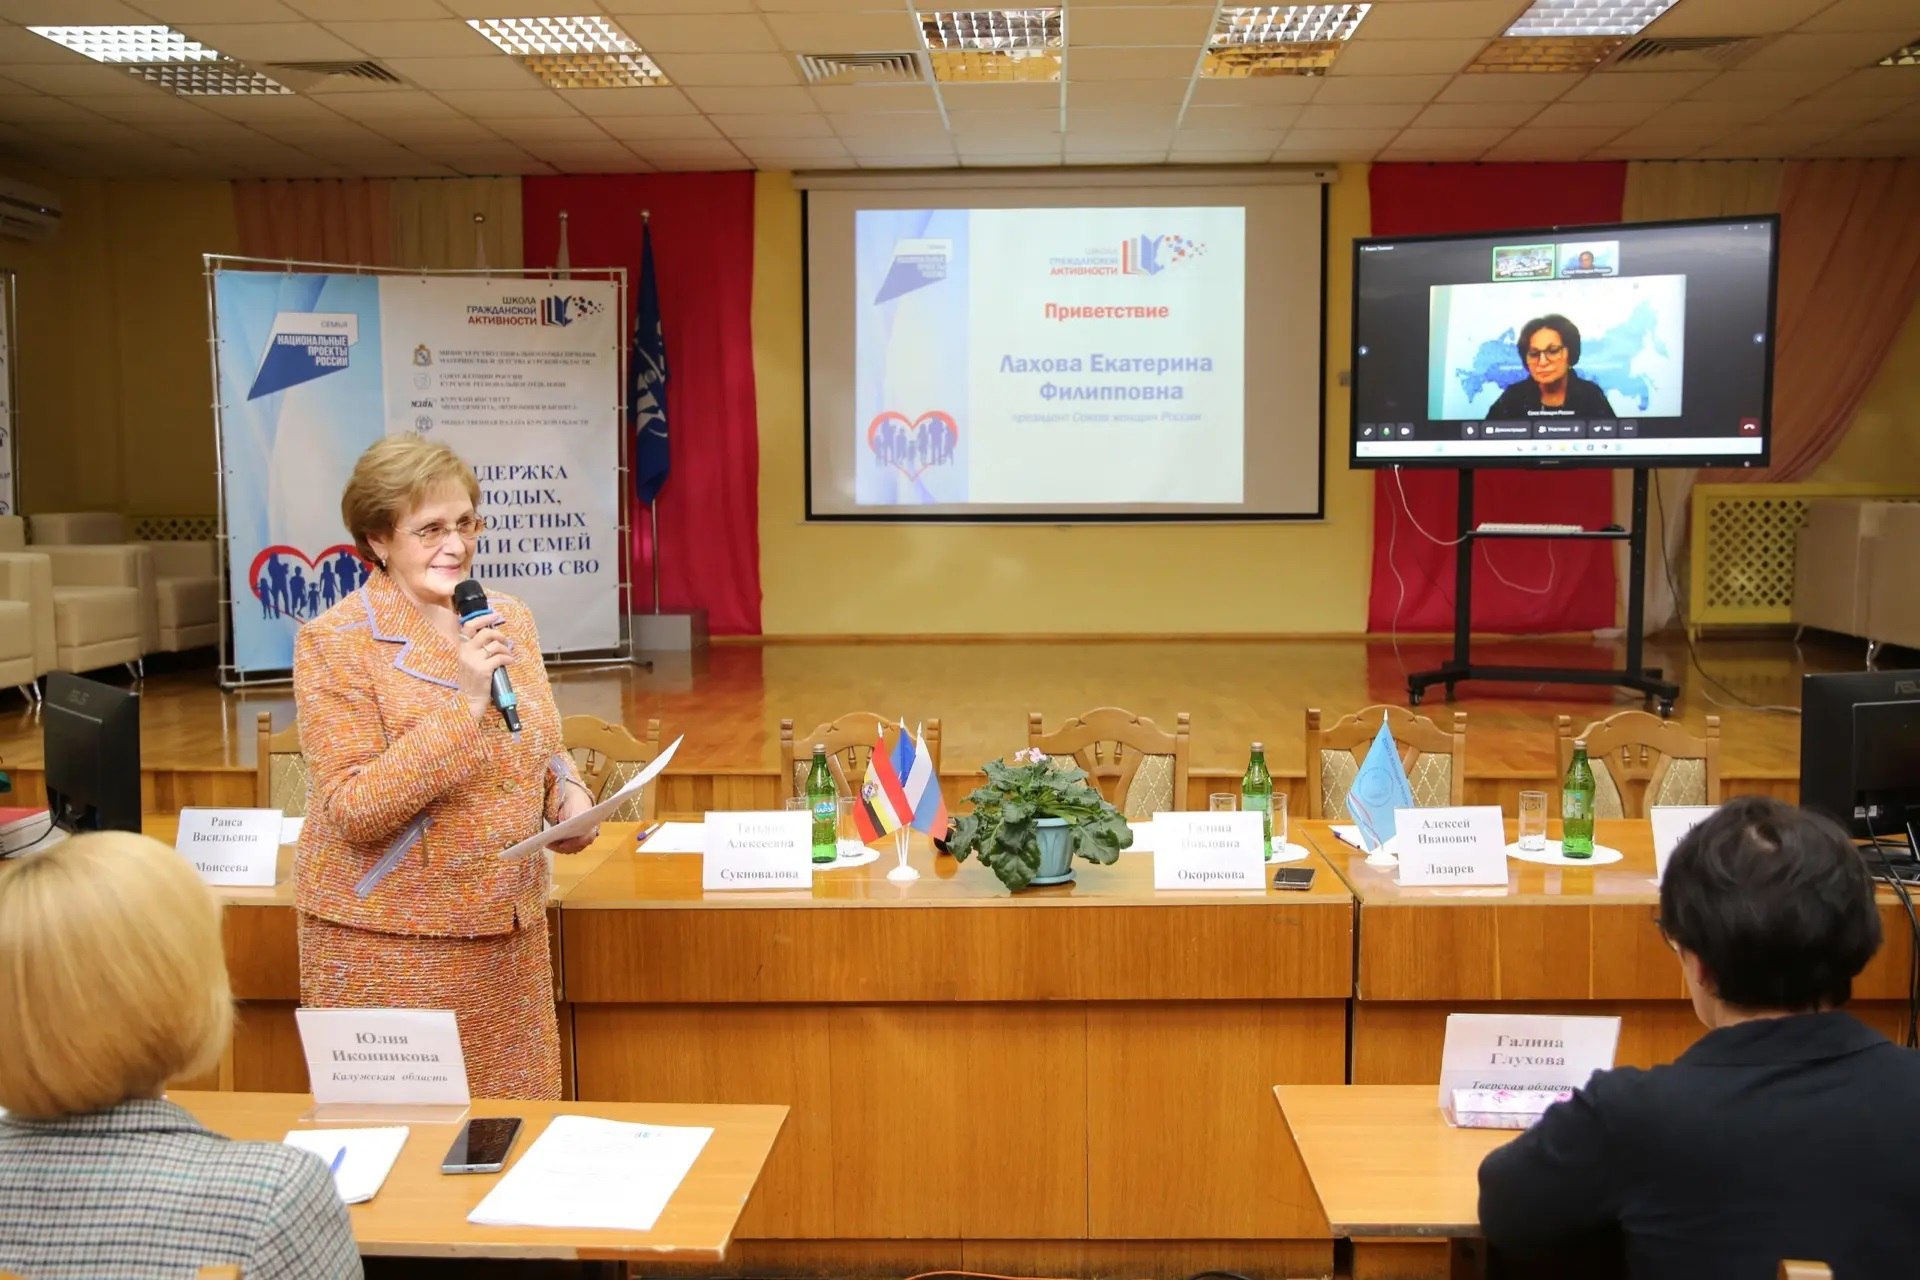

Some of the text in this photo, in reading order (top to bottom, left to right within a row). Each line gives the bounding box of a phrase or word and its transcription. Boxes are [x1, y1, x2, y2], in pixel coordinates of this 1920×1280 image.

[1050, 267, 1118, 276] АКТИВНОСТИ
[502, 296, 537, 305] ШКОЛА
[466, 305, 537, 315] ГРАЖДАНСКОЙ
[1045, 303, 1169, 322] Приветствие
[468, 316, 538, 326] АКТИВНОСТИ
[277, 334, 347, 346] НАЦИОНАЛЬНЫЕ
[308, 346, 348, 356] ПРОЕКТЫ
[315, 356, 348, 367] РОССИИ
[1000, 353, 1213, 375] Лахова Екатерина
[1040, 381, 1184, 401] Филипповна
[474, 465, 568, 481] ДЕРЖКА
[479, 489, 562, 507] ЛОДЫХ,
[484, 512, 587, 531] ОДЕТНЫХ
[498, 539, 511, 554] И
[518, 532, 591, 552] СЕМЕЙ
[470, 559, 600, 578] ТНИКОВ СВО
[211, 816, 243, 827] Раиса
[1422, 819, 1470, 829] Алексей
[193, 832, 258, 842] Васильевна
[1418, 834, 1477, 844] Иванович
[726, 839, 794, 849] Алексеевна
[196, 862, 249, 872] Моисеева
[1425, 864, 1474, 876] Лазарев
[720, 868, 799, 882] Сукновалова
[1178, 869, 1245, 882] Окорокова
[356, 1032, 408, 1044] Юлия
[1497, 1035, 1564, 1048] Галина
[331, 1050, 440, 1063] Иконникова
[1490, 1053, 1565, 1067] Глухова
[331, 1071, 448, 1083] Калужская область
[1471, 1080, 1525, 1091] Тверская
